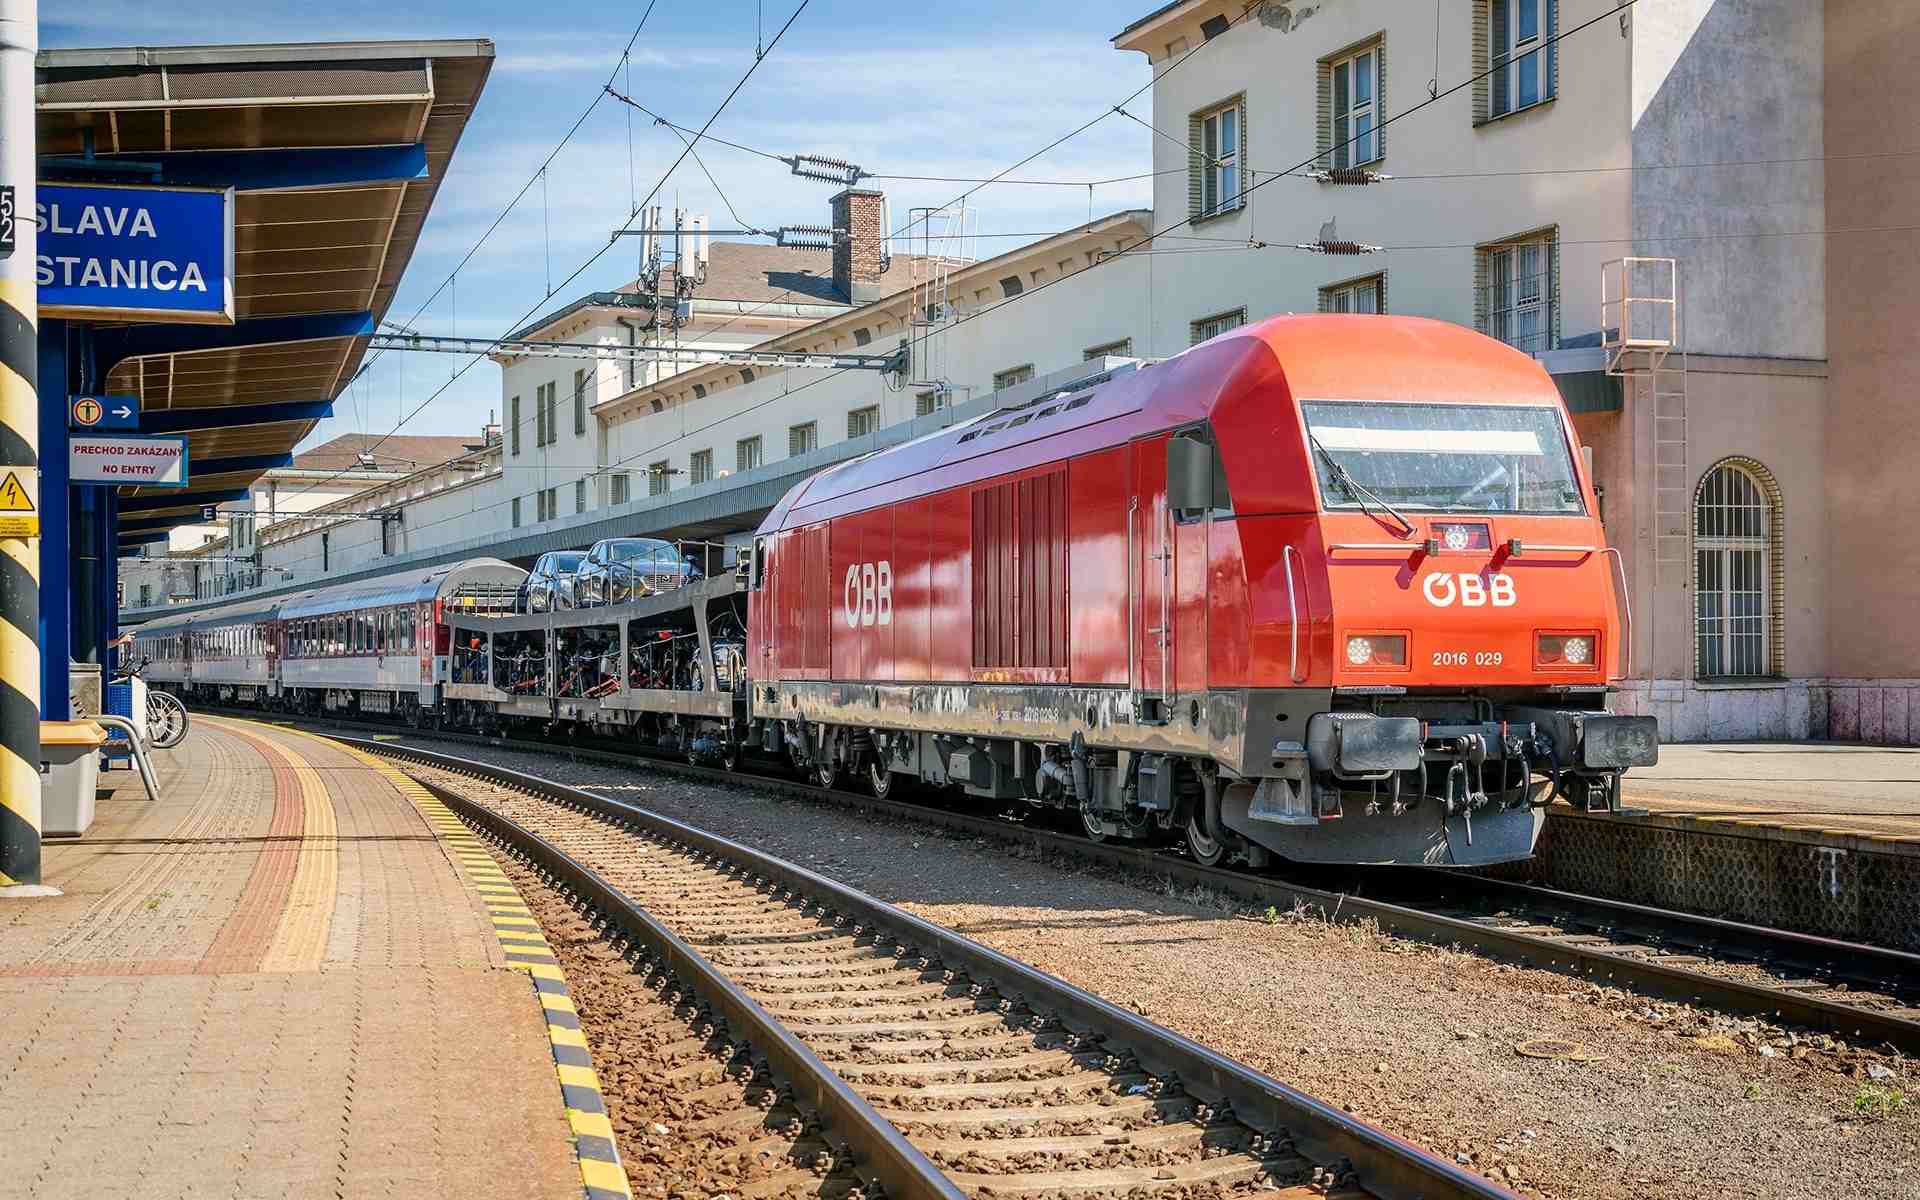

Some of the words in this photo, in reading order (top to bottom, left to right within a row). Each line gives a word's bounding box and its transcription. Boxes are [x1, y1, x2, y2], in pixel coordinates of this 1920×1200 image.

[36, 255, 208, 292] STANICA
[74, 445, 124, 455] PRECHOD
[102, 465, 118, 474] NO
[121, 465, 156, 475] ENTRY
[203, 508, 214, 519] E
[845, 561, 893, 628] ÖBB
[1423, 572, 1517, 607] ÖBB
[1432, 652, 1468, 666] 2016
[1475, 652, 1503, 666] 029
